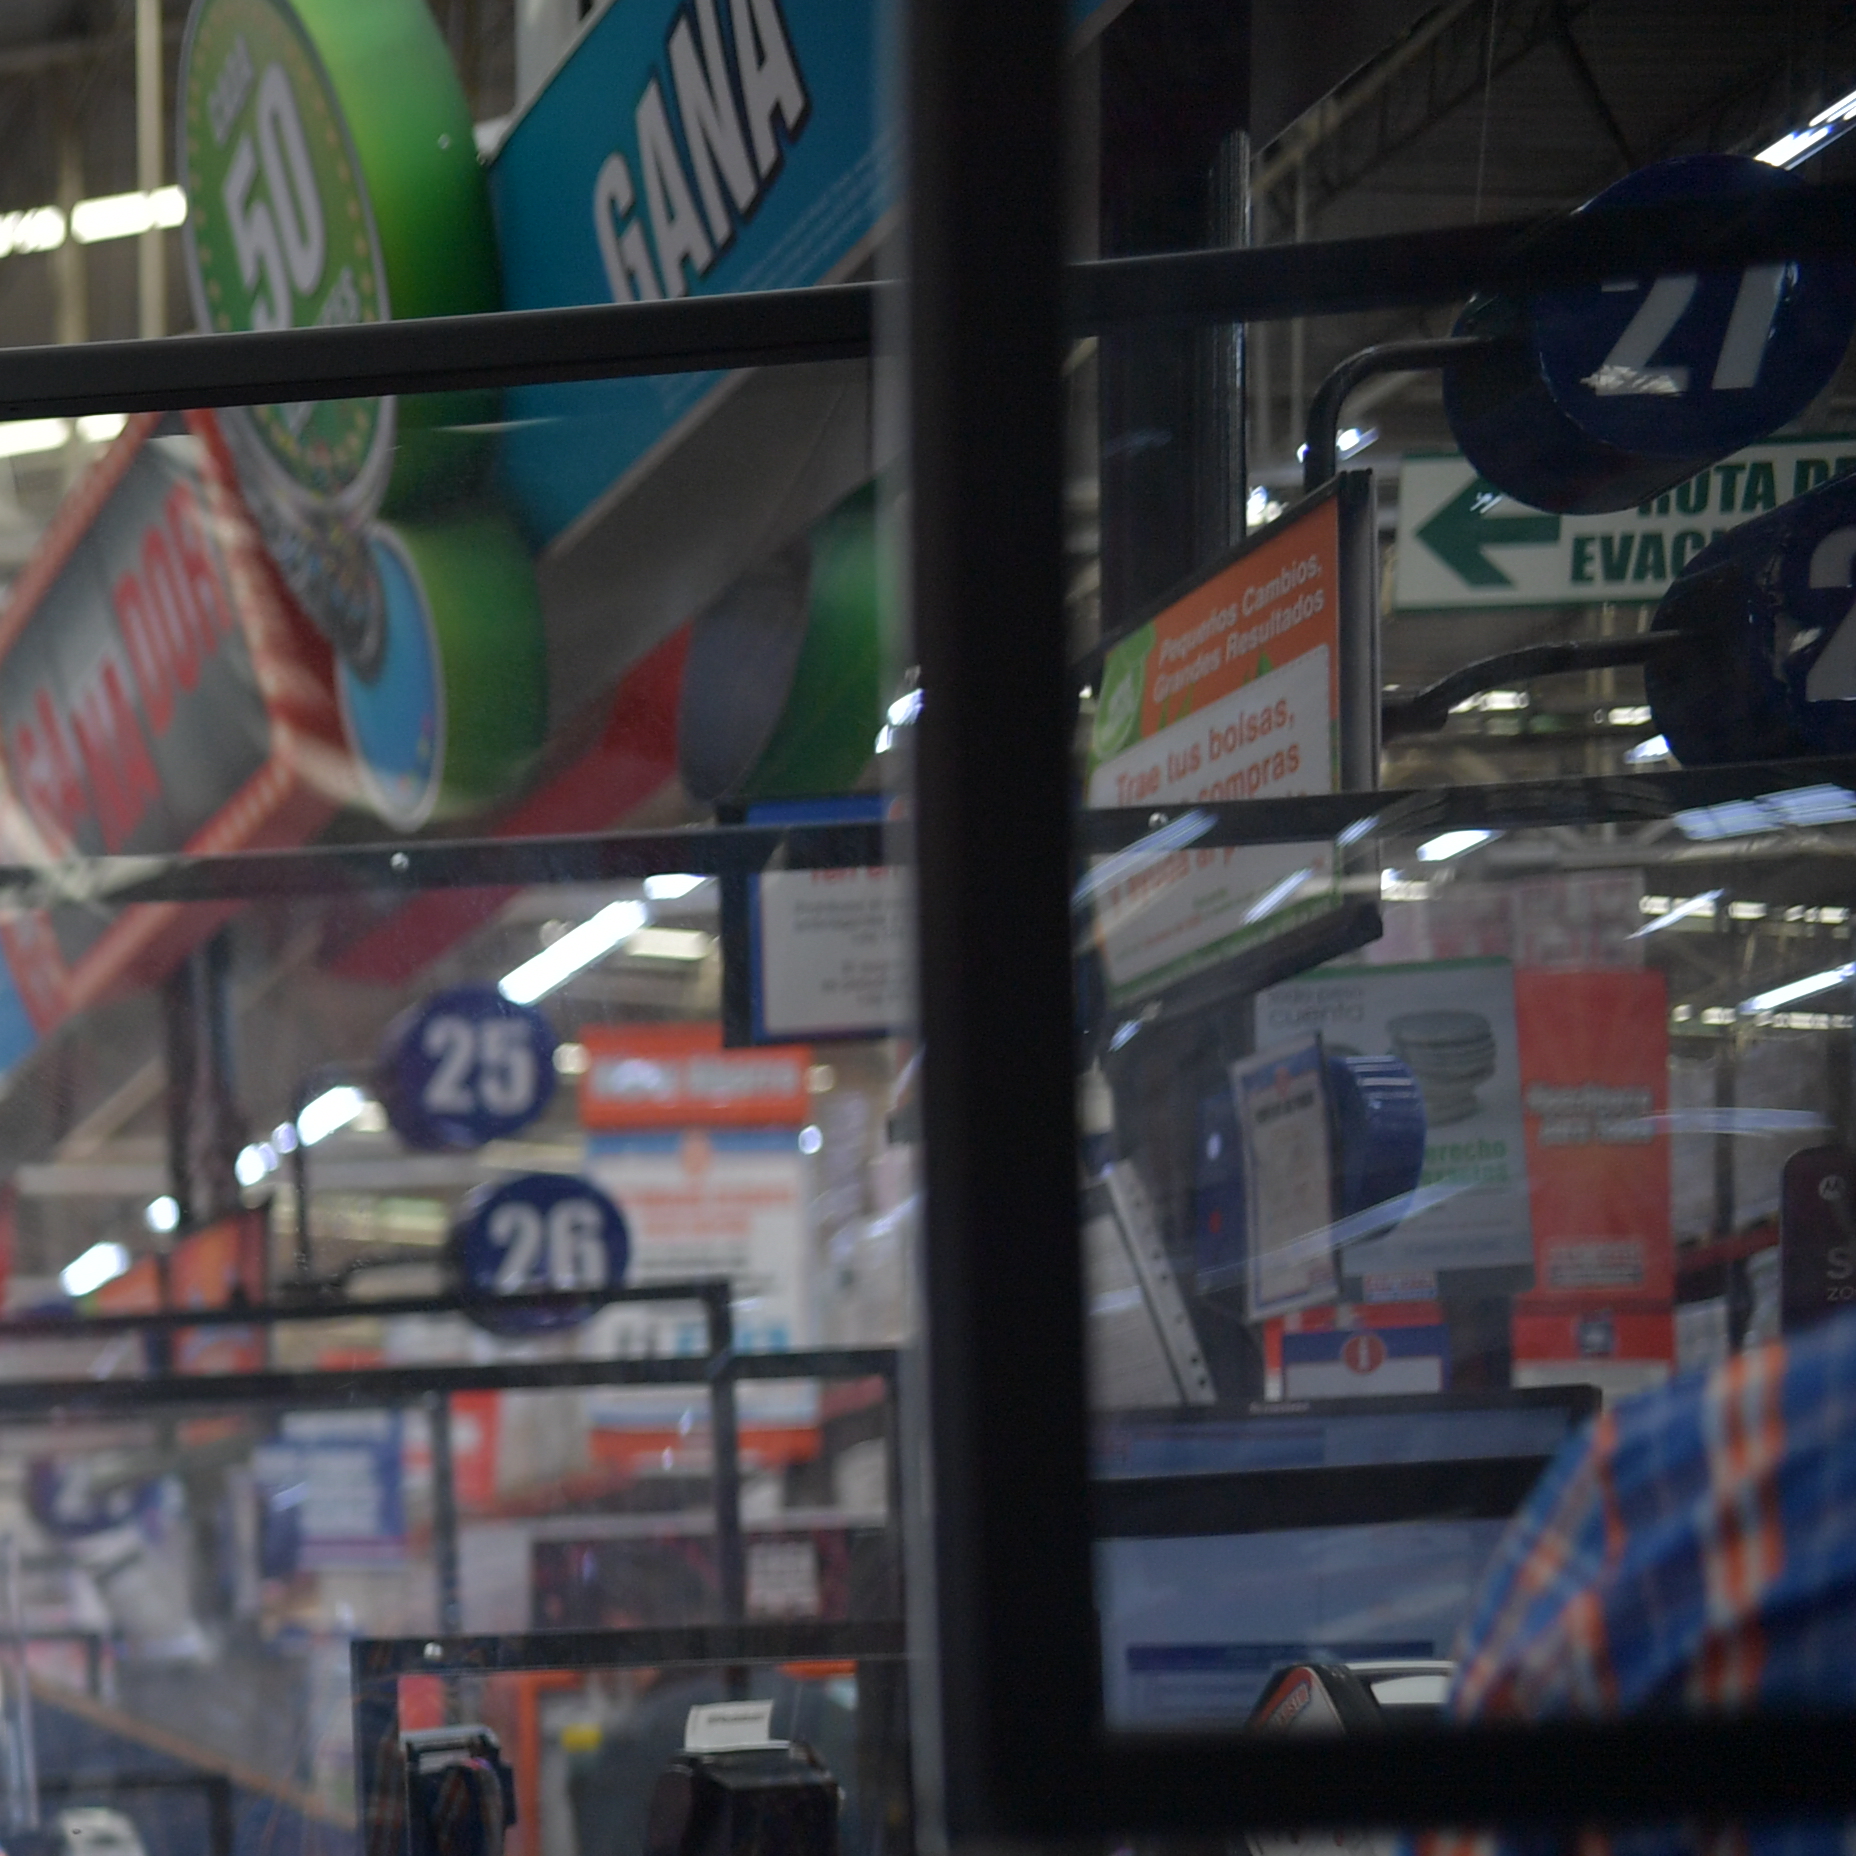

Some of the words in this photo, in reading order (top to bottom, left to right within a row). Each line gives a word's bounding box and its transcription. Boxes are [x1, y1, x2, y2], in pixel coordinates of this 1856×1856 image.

[595, 0, 809, 302] GANA
[224, 61, 325, 332] 50
[1591, 260, 1797, 398] 27
[1241, 554, 1323, 618] Cambios,
[1569, 527, 1731, 586] EVAC
[1225, 588, 1325, 663] Resultados
[1166, 743, 1202, 784] tus
[1208, 698, 1296, 762] bolsas,
[421, 1014, 535, 1115] 25
[490, 1201, 608, 1291] 26
